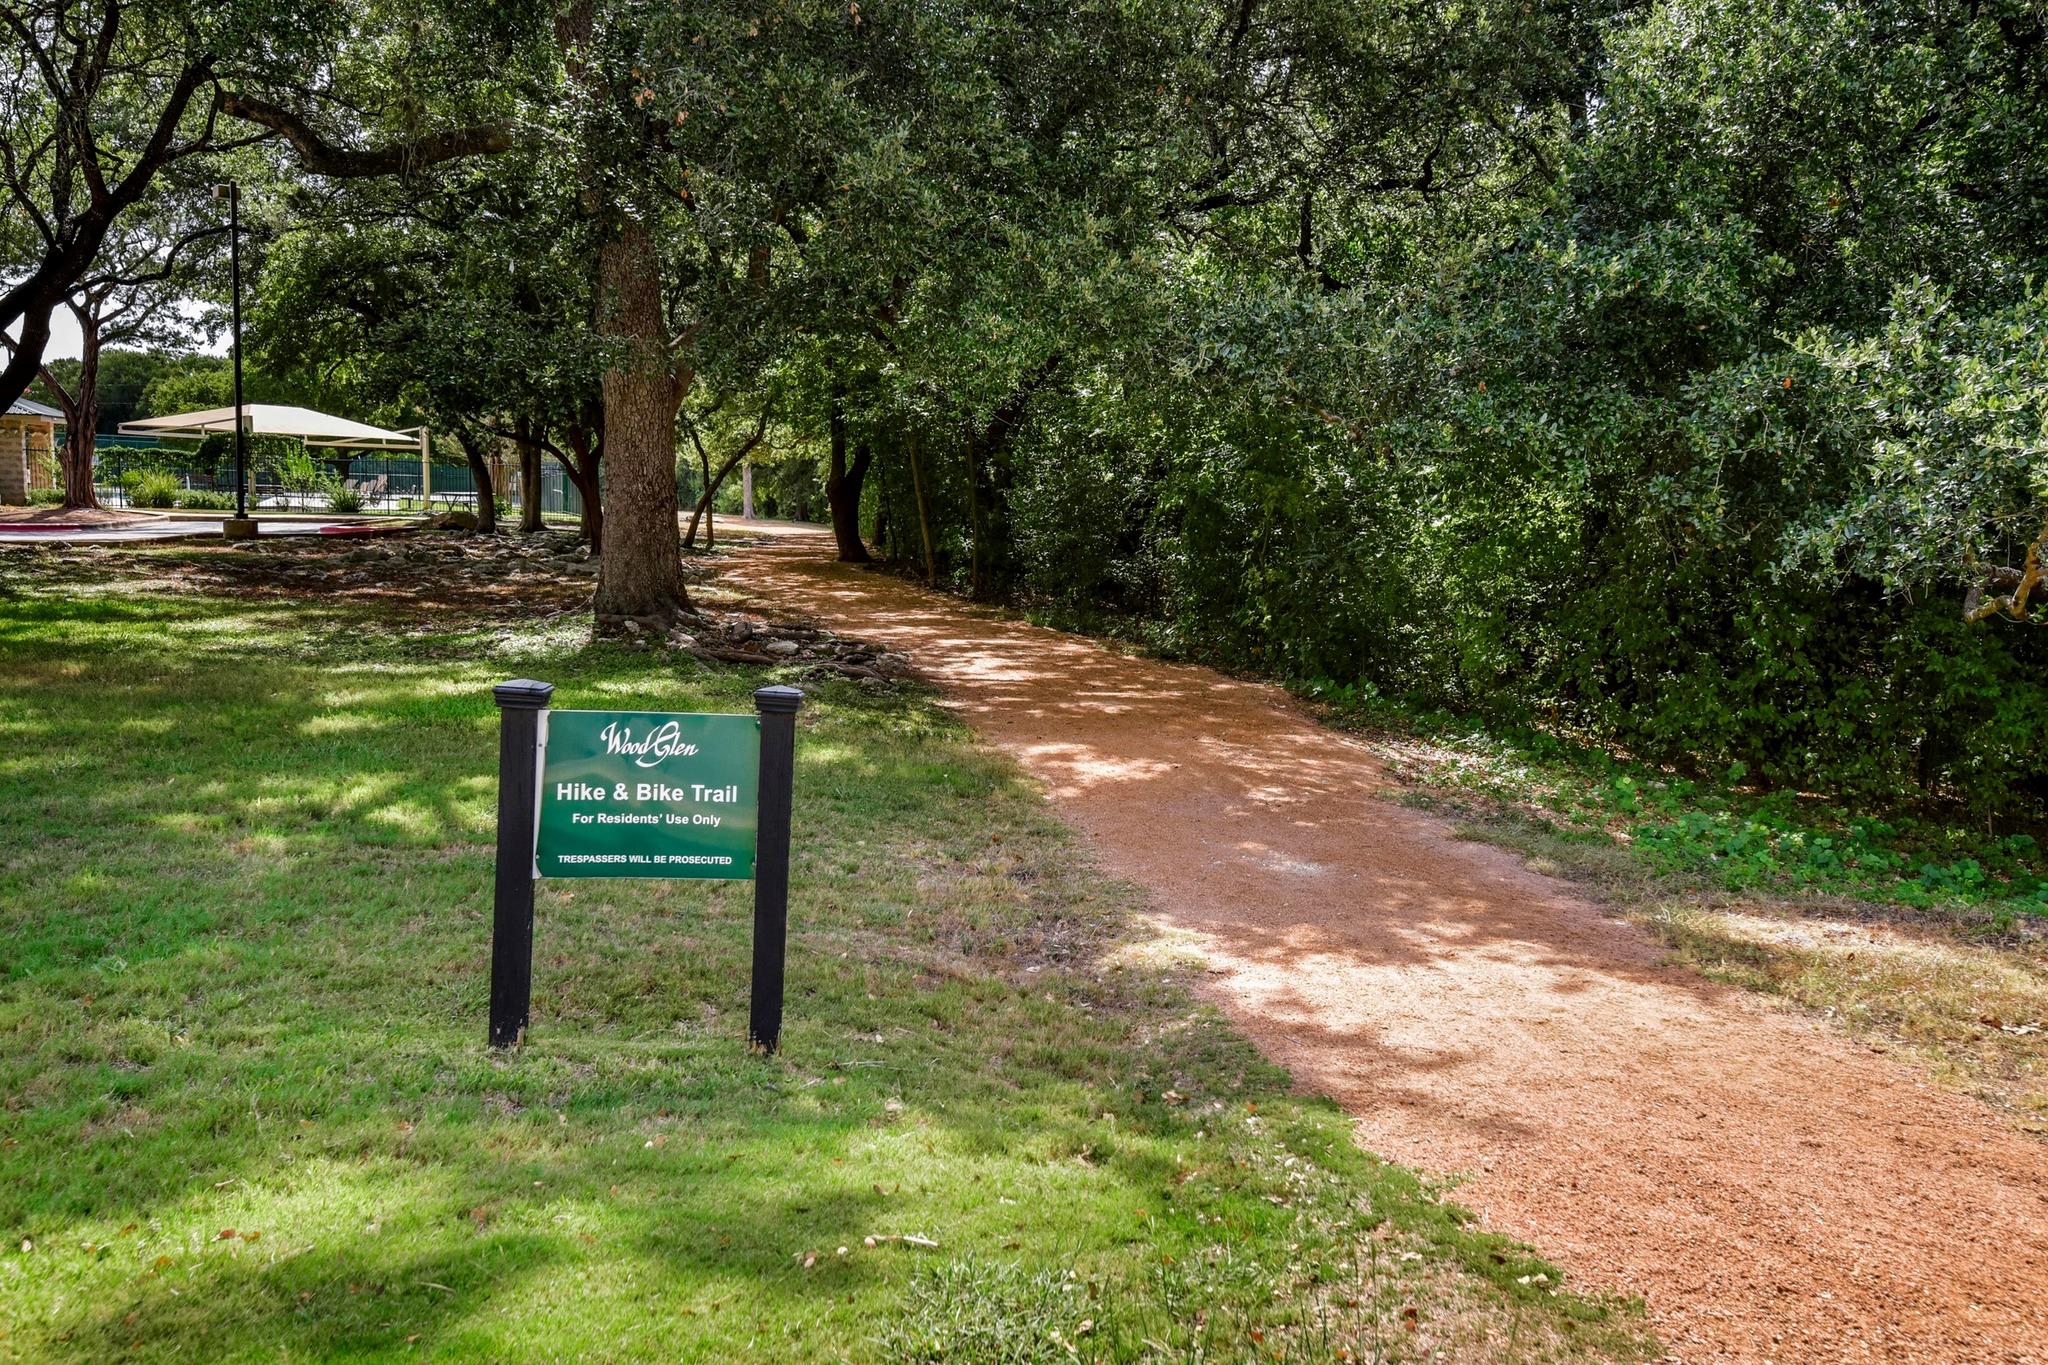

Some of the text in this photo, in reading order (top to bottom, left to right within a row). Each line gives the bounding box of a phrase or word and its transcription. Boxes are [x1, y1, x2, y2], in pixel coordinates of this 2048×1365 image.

[556, 783, 738, 803] Hike & Bike Trail
[572, 813, 722, 828] For Residents' Use Only
[557, 855, 733, 865] TRESPASSERS WILL BE PROSECUTED
